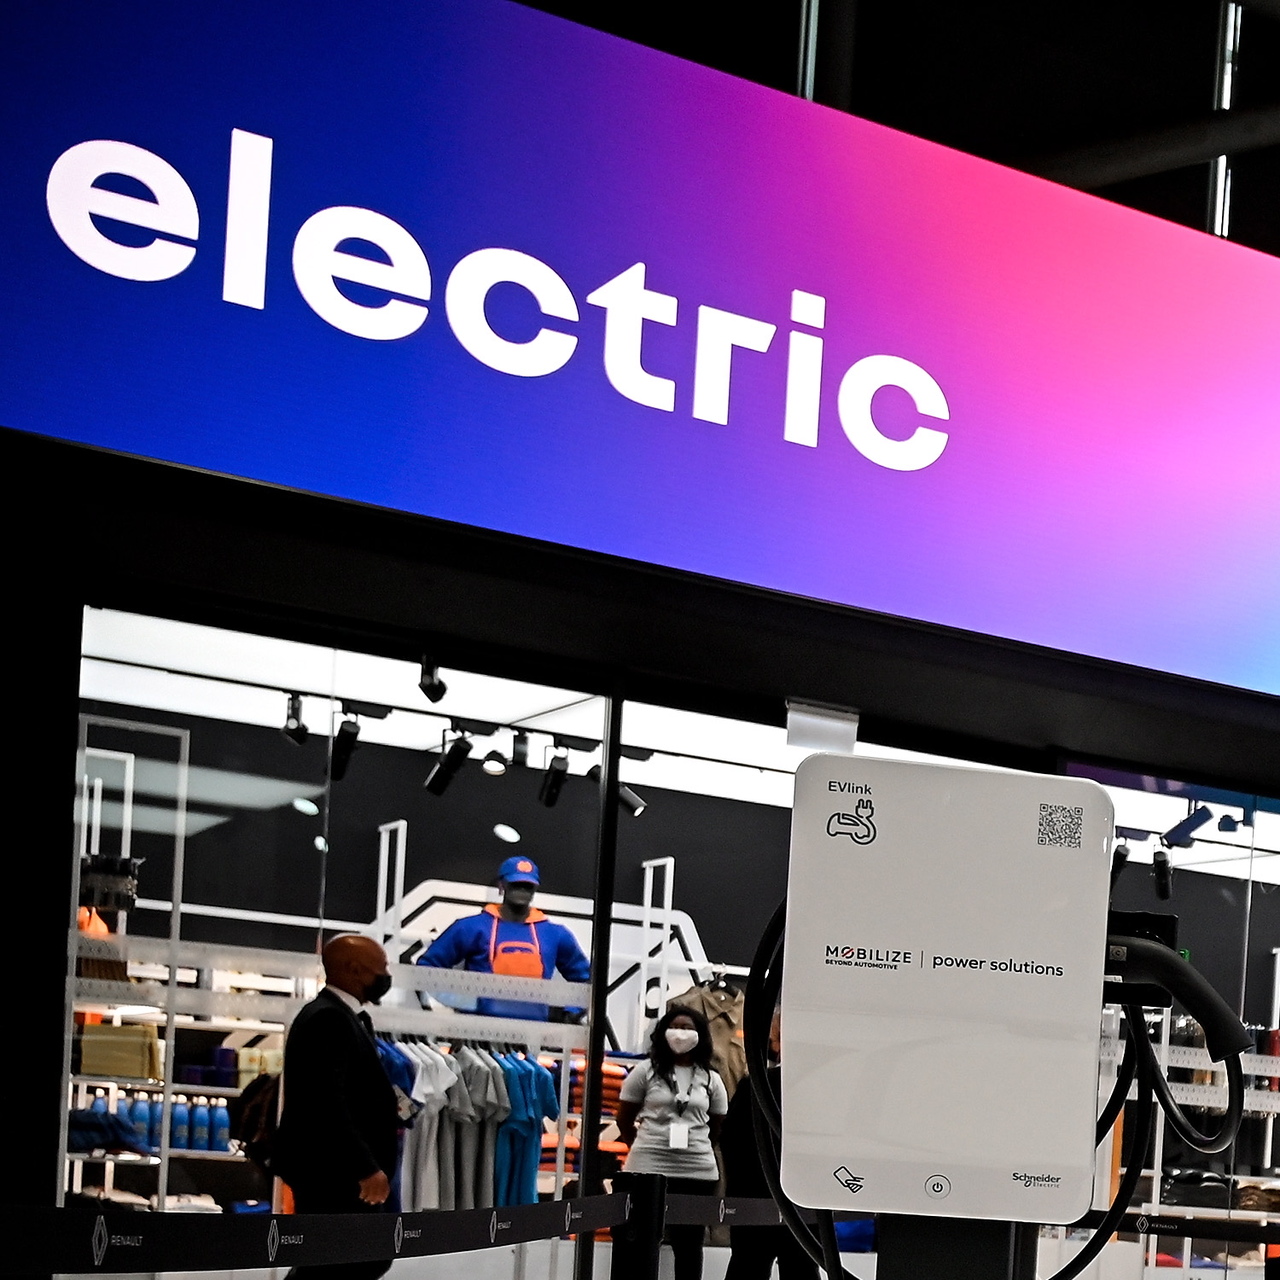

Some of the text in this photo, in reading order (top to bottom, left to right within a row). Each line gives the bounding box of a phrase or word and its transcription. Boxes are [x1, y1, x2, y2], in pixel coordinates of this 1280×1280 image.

[46, 127, 951, 472] electric
[828, 780, 872, 795] EVlink
[825, 959, 898, 970] BEYOND AUTOMOTIVE
[933, 956, 986, 969] power
[990, 958, 1064, 976] solutions
[1012, 1172, 1061, 1188] Schneider
[111, 1234, 143, 1247] RENAULT
[280, 1234, 304, 1246] RENAULT
